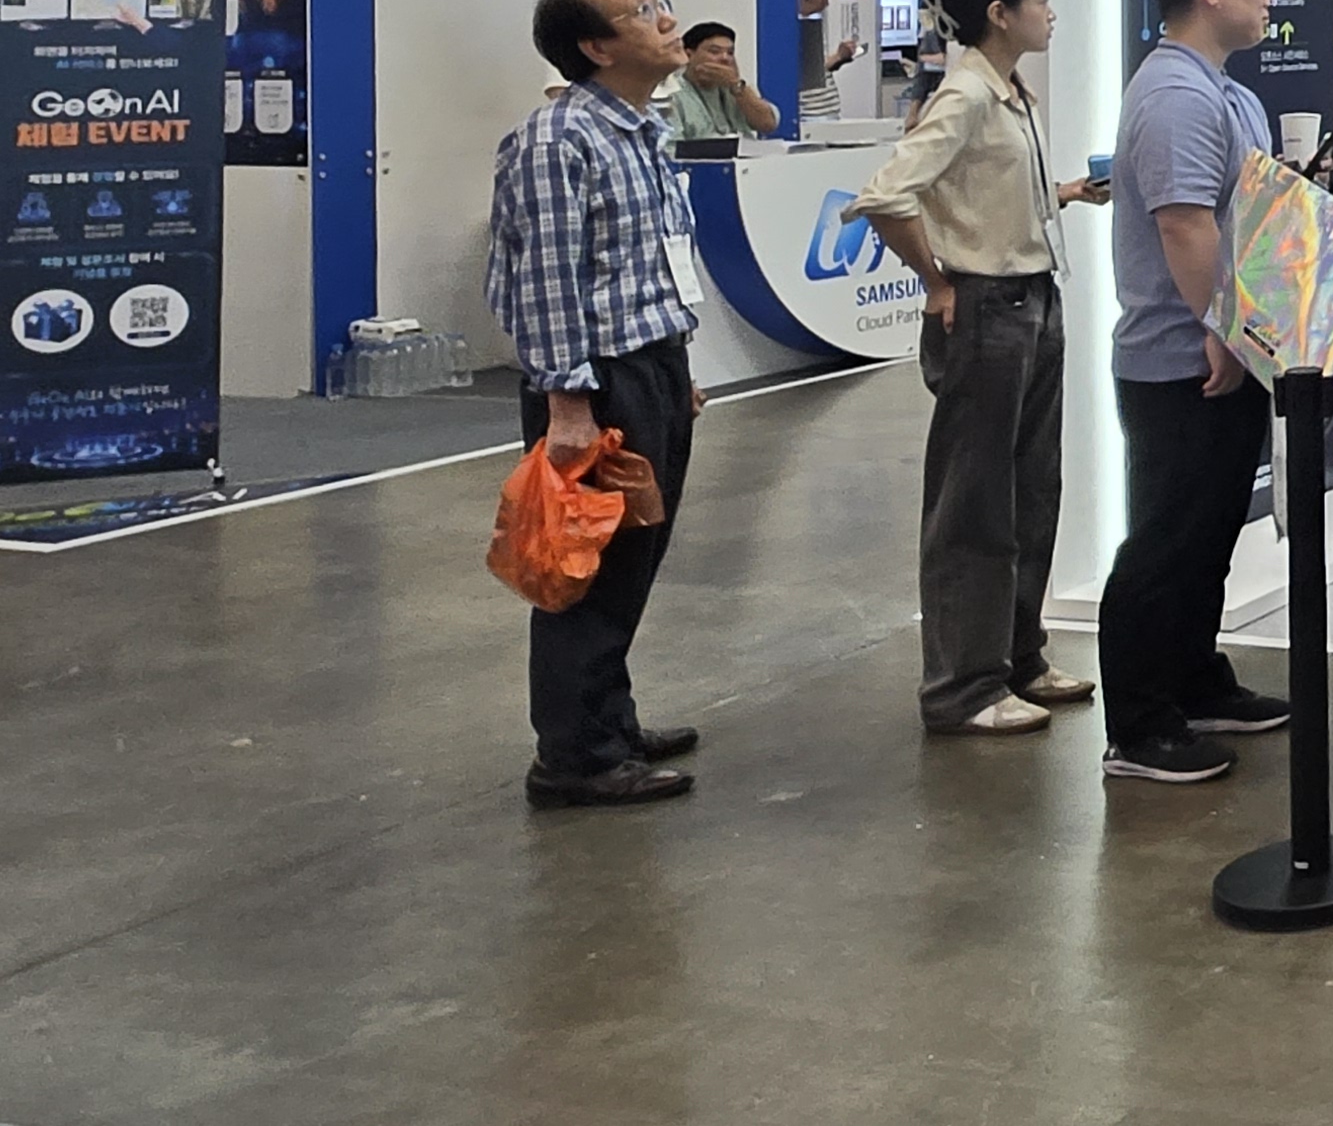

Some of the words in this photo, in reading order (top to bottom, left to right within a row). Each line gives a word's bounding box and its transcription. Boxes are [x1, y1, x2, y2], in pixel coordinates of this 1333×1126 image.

[146, 88, 180, 114] AI
[87, 119, 191, 145] EVENT
[857, 312, 893, 333] Cloud
